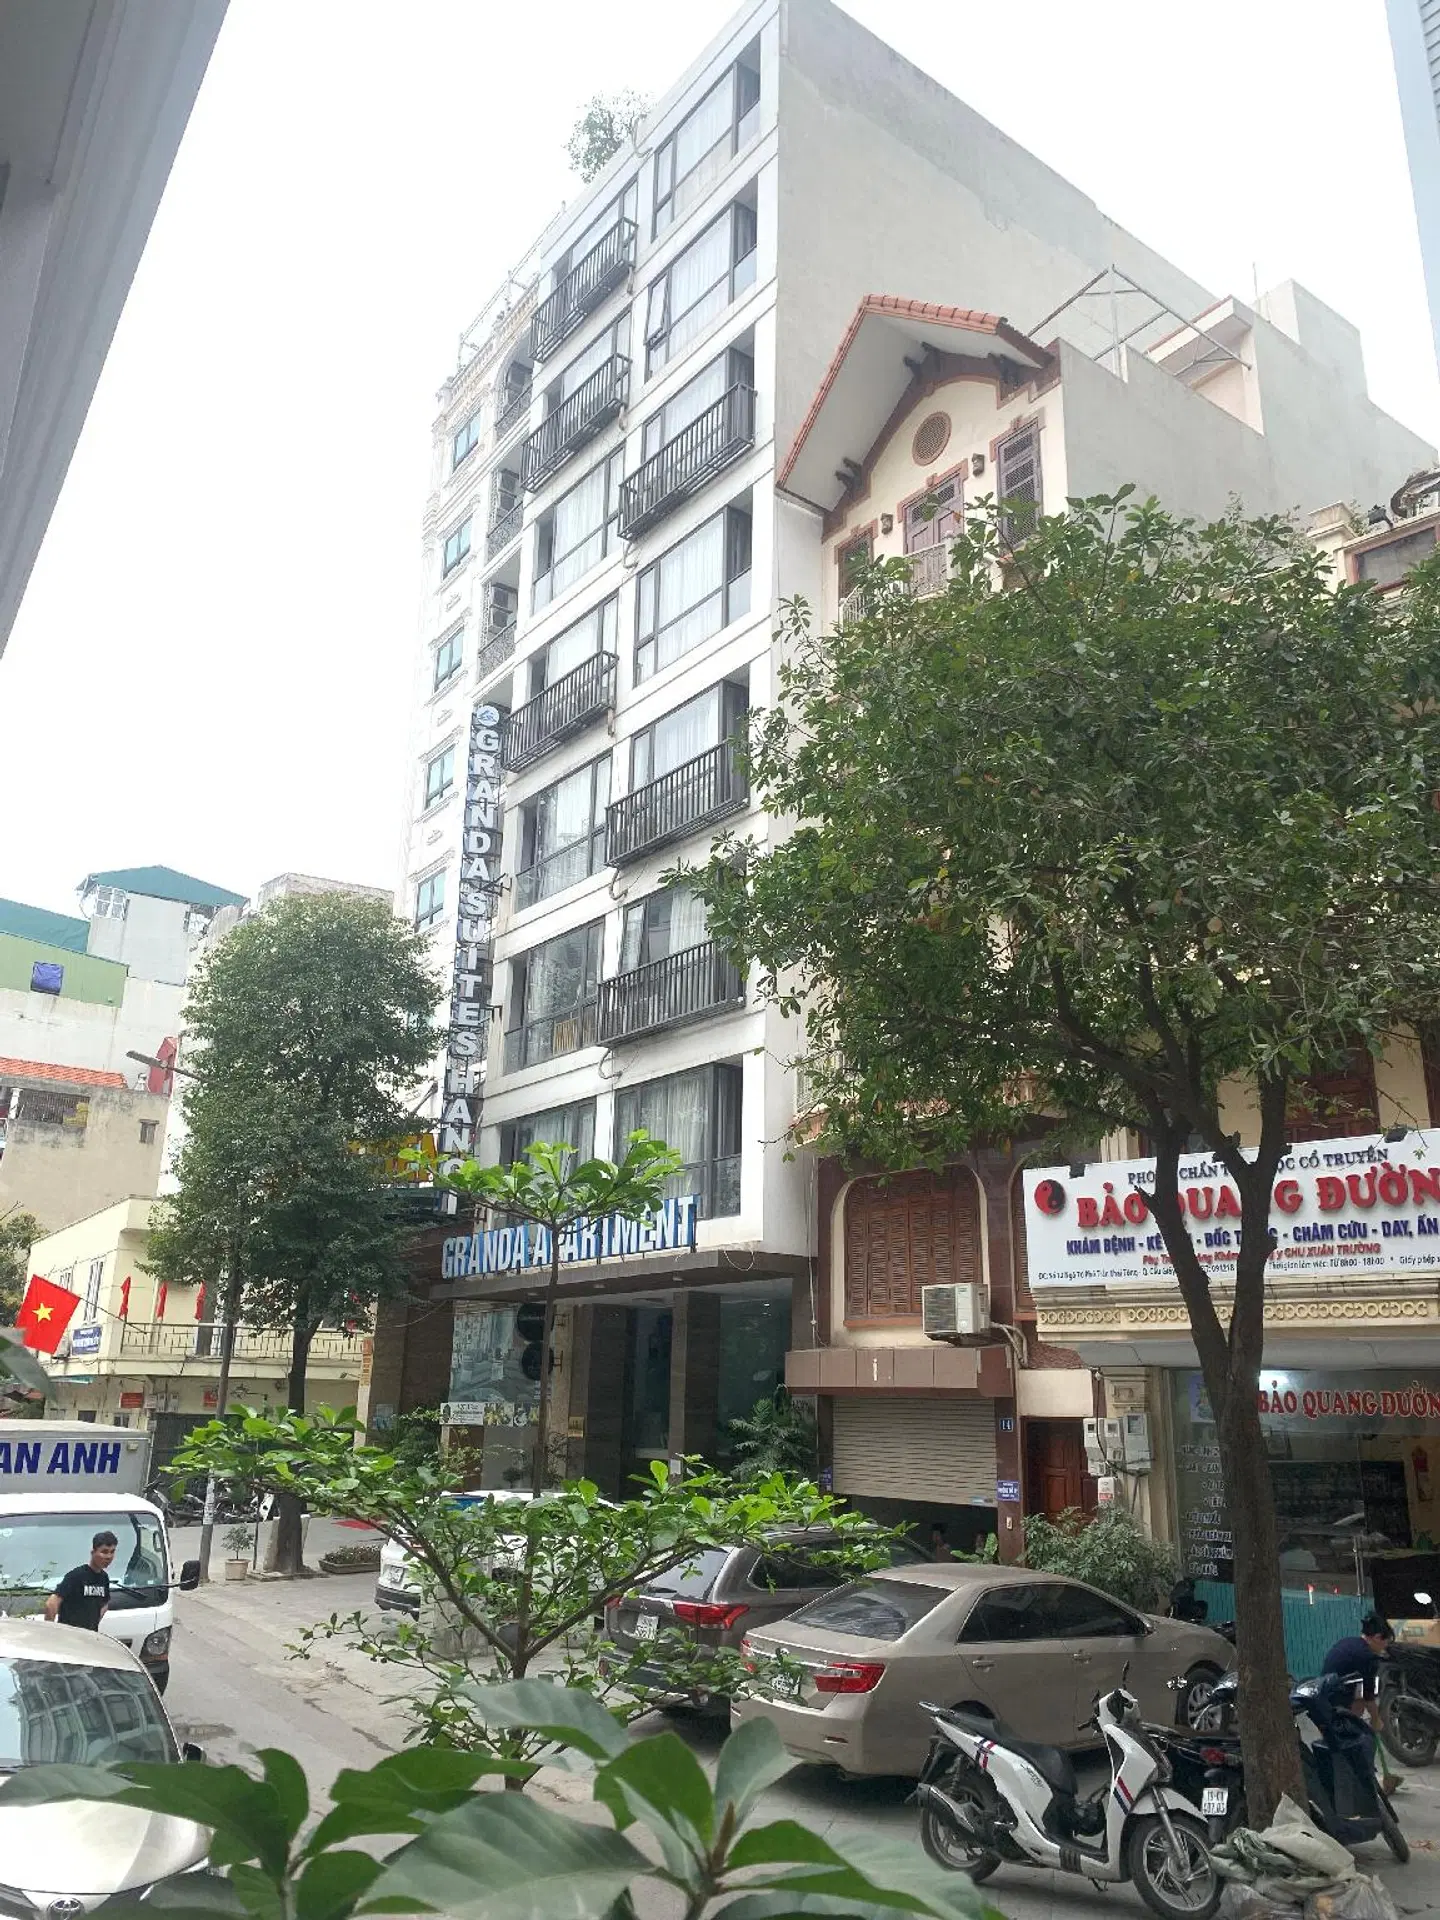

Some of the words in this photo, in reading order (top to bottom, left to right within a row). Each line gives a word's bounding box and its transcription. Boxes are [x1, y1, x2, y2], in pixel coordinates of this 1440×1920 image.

[464, 728, 500, 882] GRANDA
[453, 891, 488, 1058] SUITES
[1127, 1171, 1156, 1186] PHO
[1076, 1181, 1149, 1228] BẢO
[1177, 1180, 1304, 1222] UAG
[442, 1224, 525, 1280] GRANDA
[1103, 1234, 1136, 1256] BỆNH
[1203, 1226, 1233, 1249] BỐC
[1256, 1380, 1298, 1414] BẢO
[1302, 1389, 1378, 1420] QUANG
[47, 1442, 121, 1474] ANH
